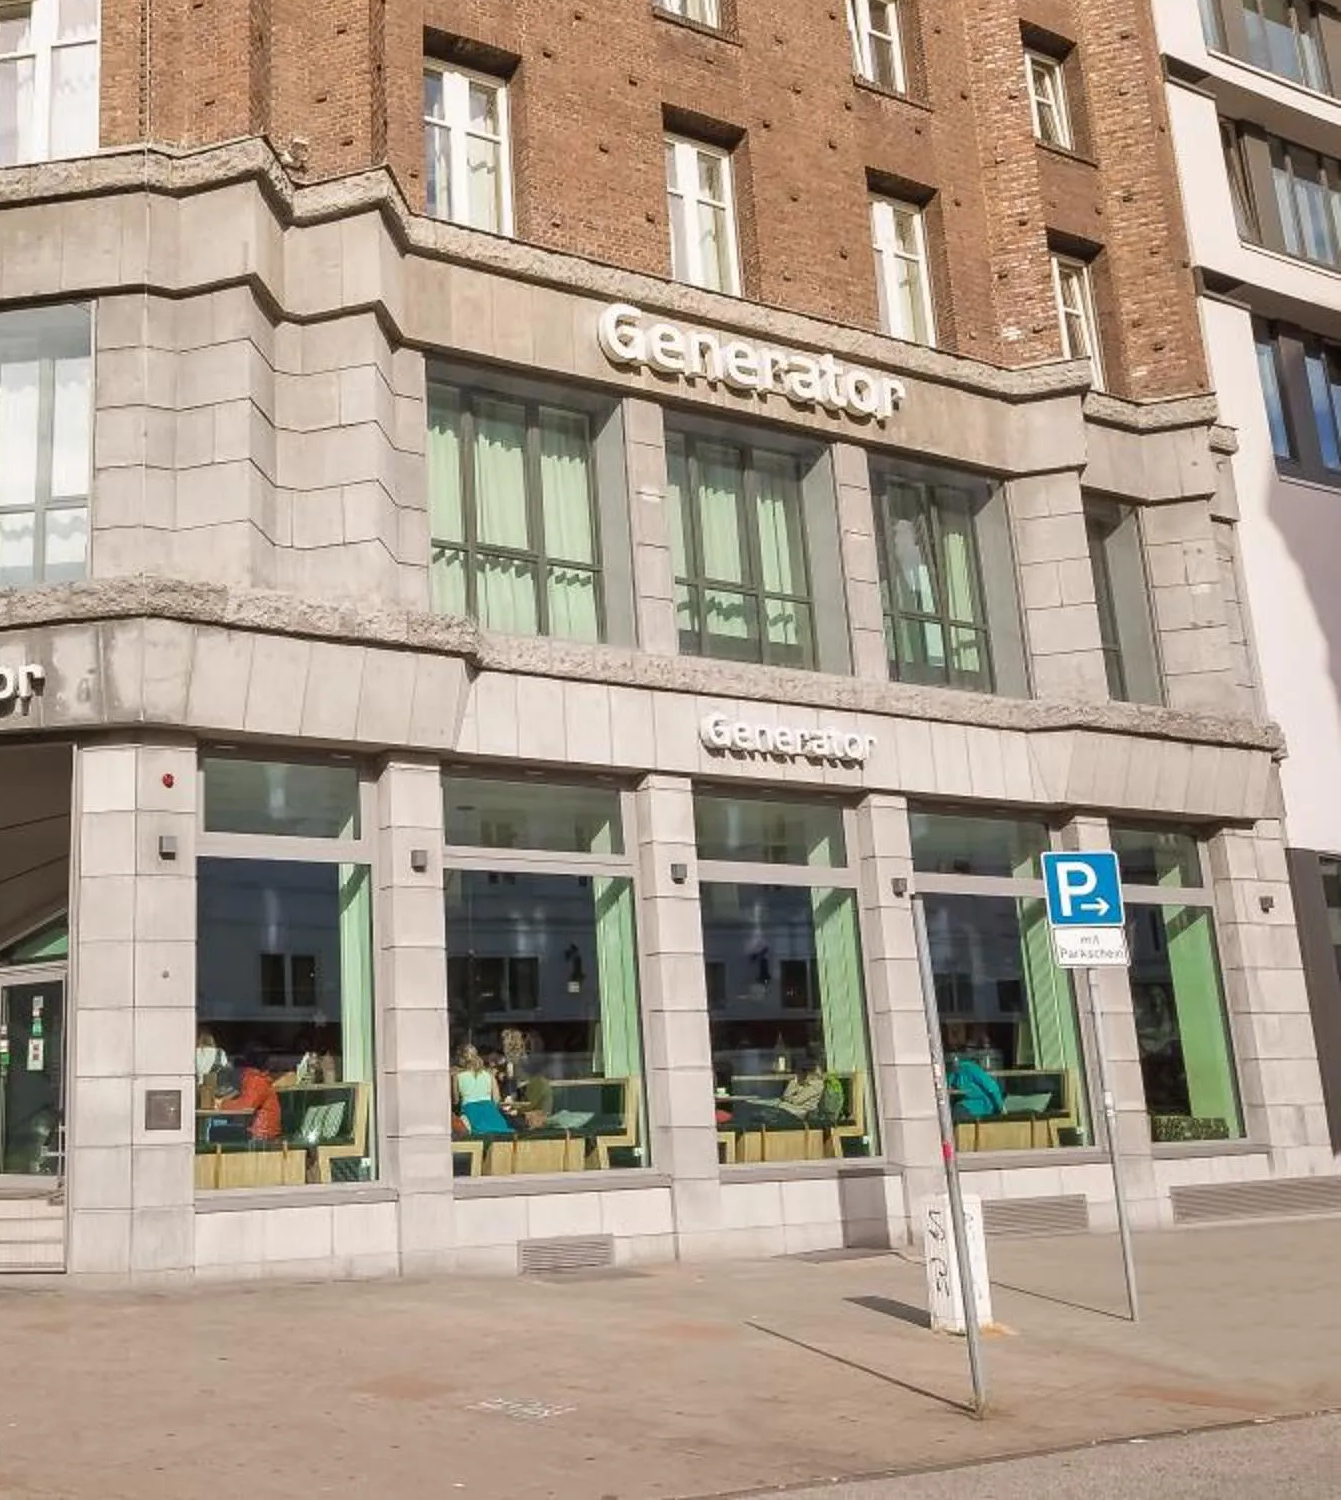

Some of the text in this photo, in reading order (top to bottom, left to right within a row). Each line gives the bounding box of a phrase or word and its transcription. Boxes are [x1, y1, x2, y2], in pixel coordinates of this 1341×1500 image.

[598, 303, 905, 418] Generator
[700, 712, 877, 760] Generator
[1056, 861, 1097, 916] P
